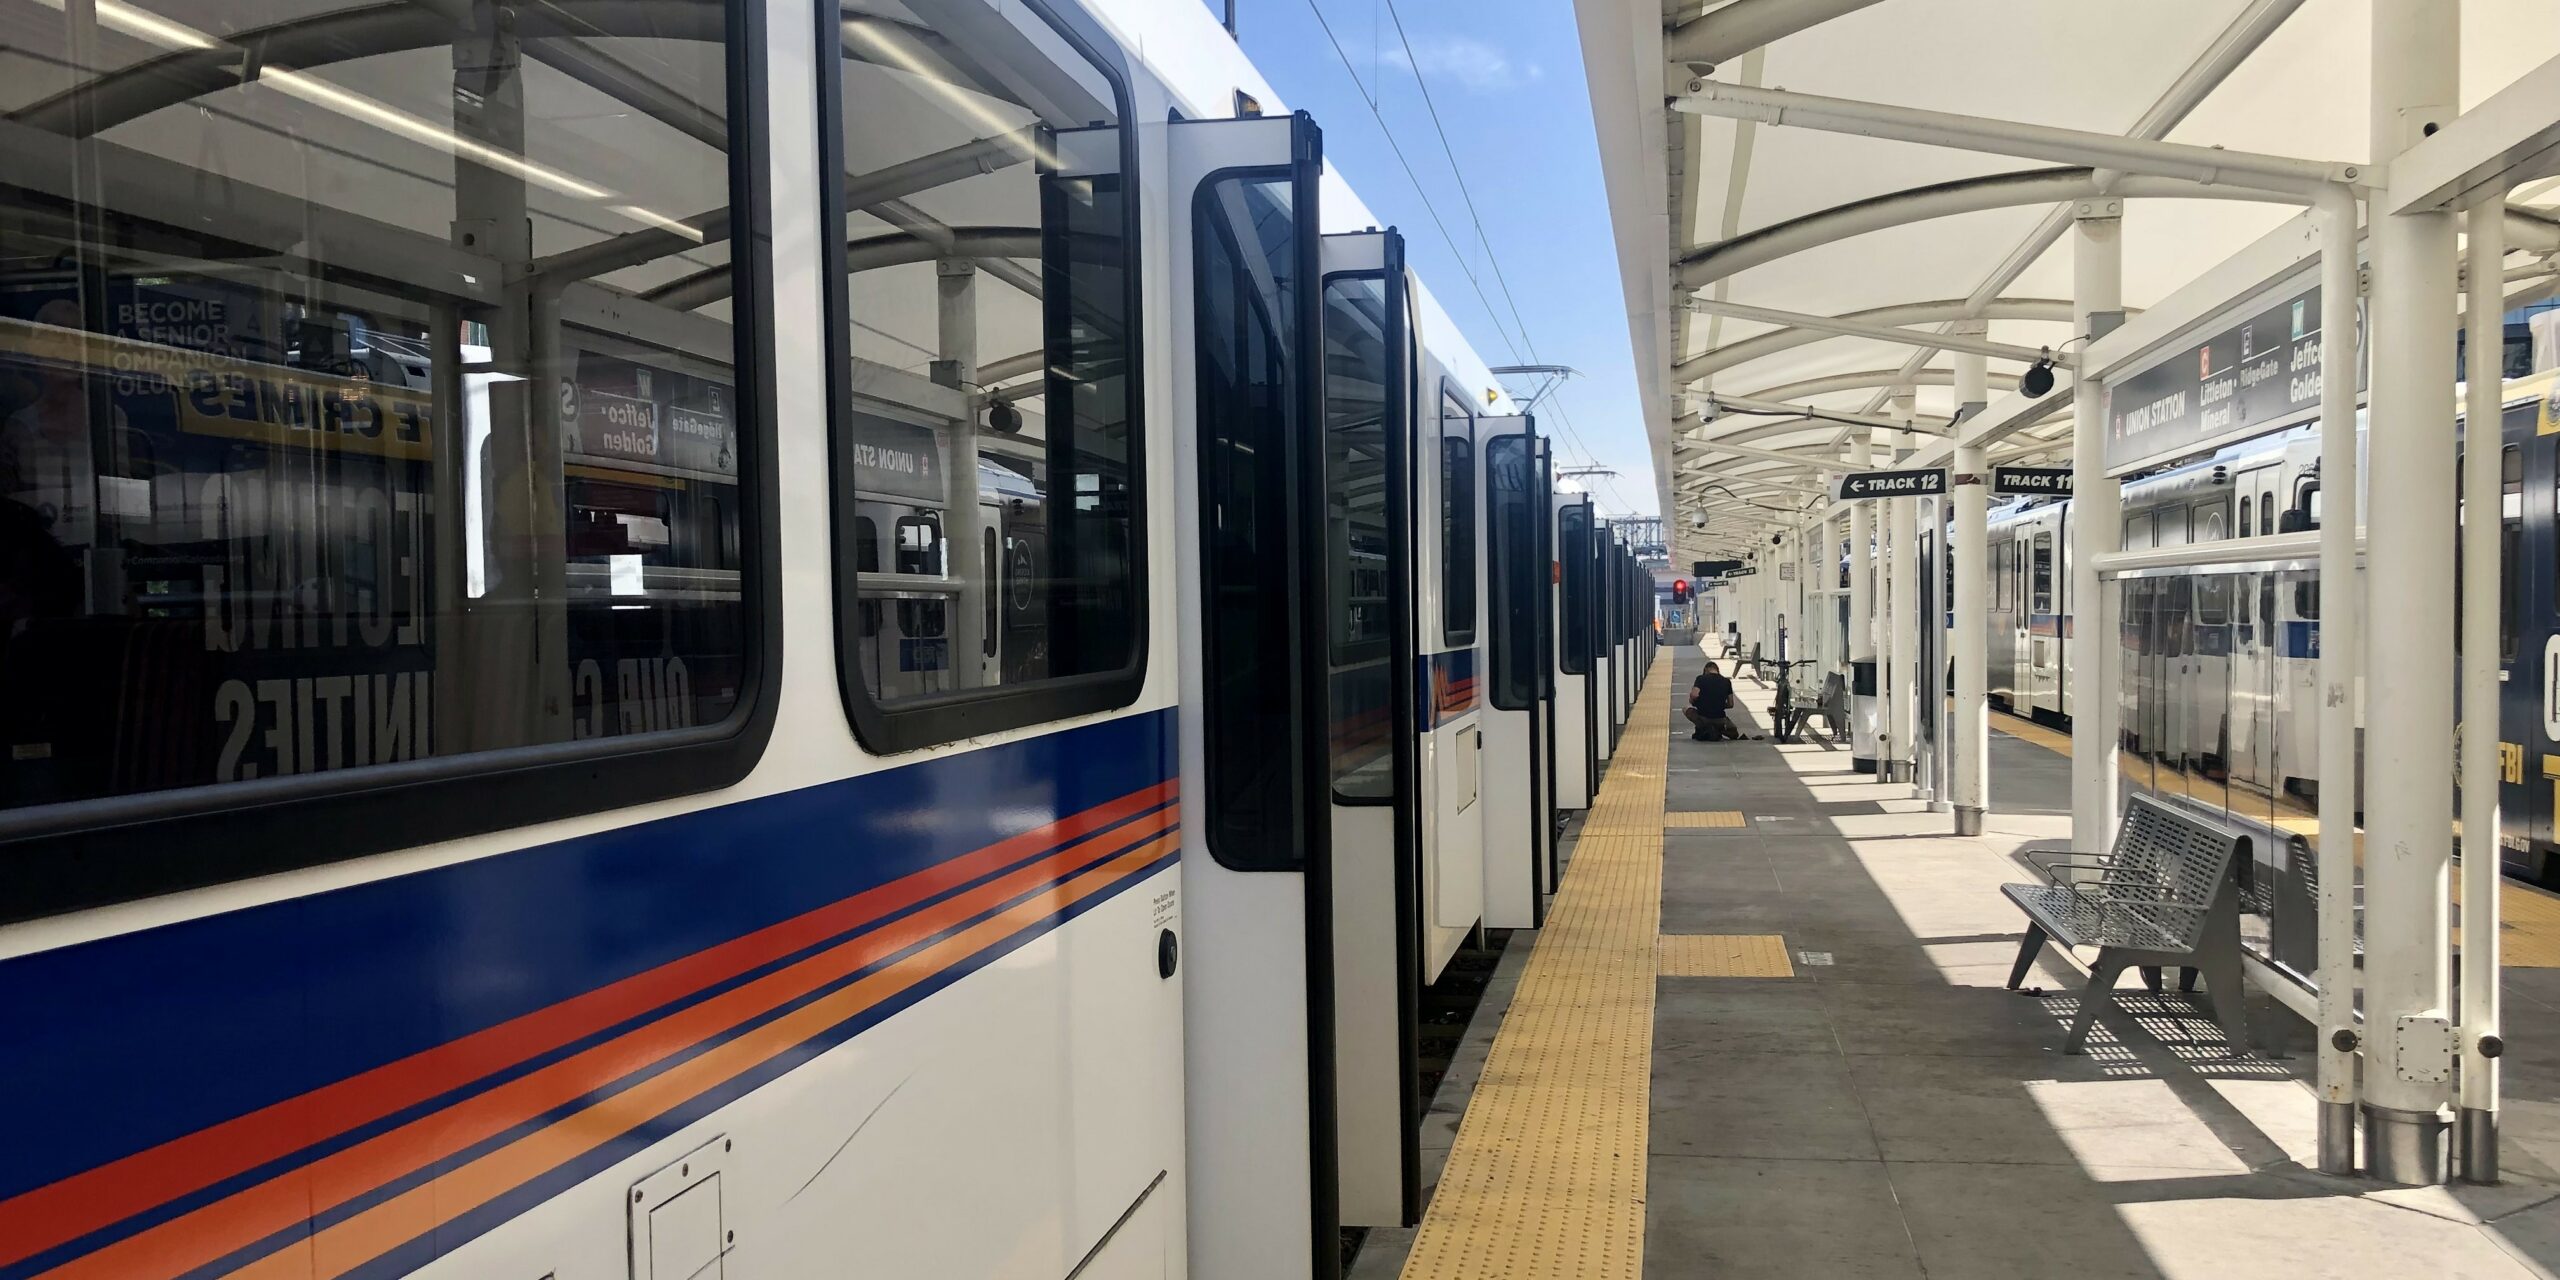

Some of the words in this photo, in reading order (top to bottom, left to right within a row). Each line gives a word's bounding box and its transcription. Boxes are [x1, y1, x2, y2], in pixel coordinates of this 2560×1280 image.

[118, 300, 224, 324] BECOME
[137, 323, 231, 347] SENIOR
[112, 344, 249, 371] OMPANION
[111, 371, 247, 397] OLUNTEER
[2200, 379, 2233, 407] Littleton
[2291, 373, 2321, 404] Golde
[2126, 405, 2150, 436] UNION
[2151, 391, 2186, 427] STATION
[2200, 402, 2230, 433] Mineral
[1868, 478, 1916, 491] TRACK
[1920, 474, 1939, 490] 12
[2002, 474, 2051, 487] TRACK
[2056, 474, 2073, 490] 11
[2497, 741, 2524, 785] FBI
